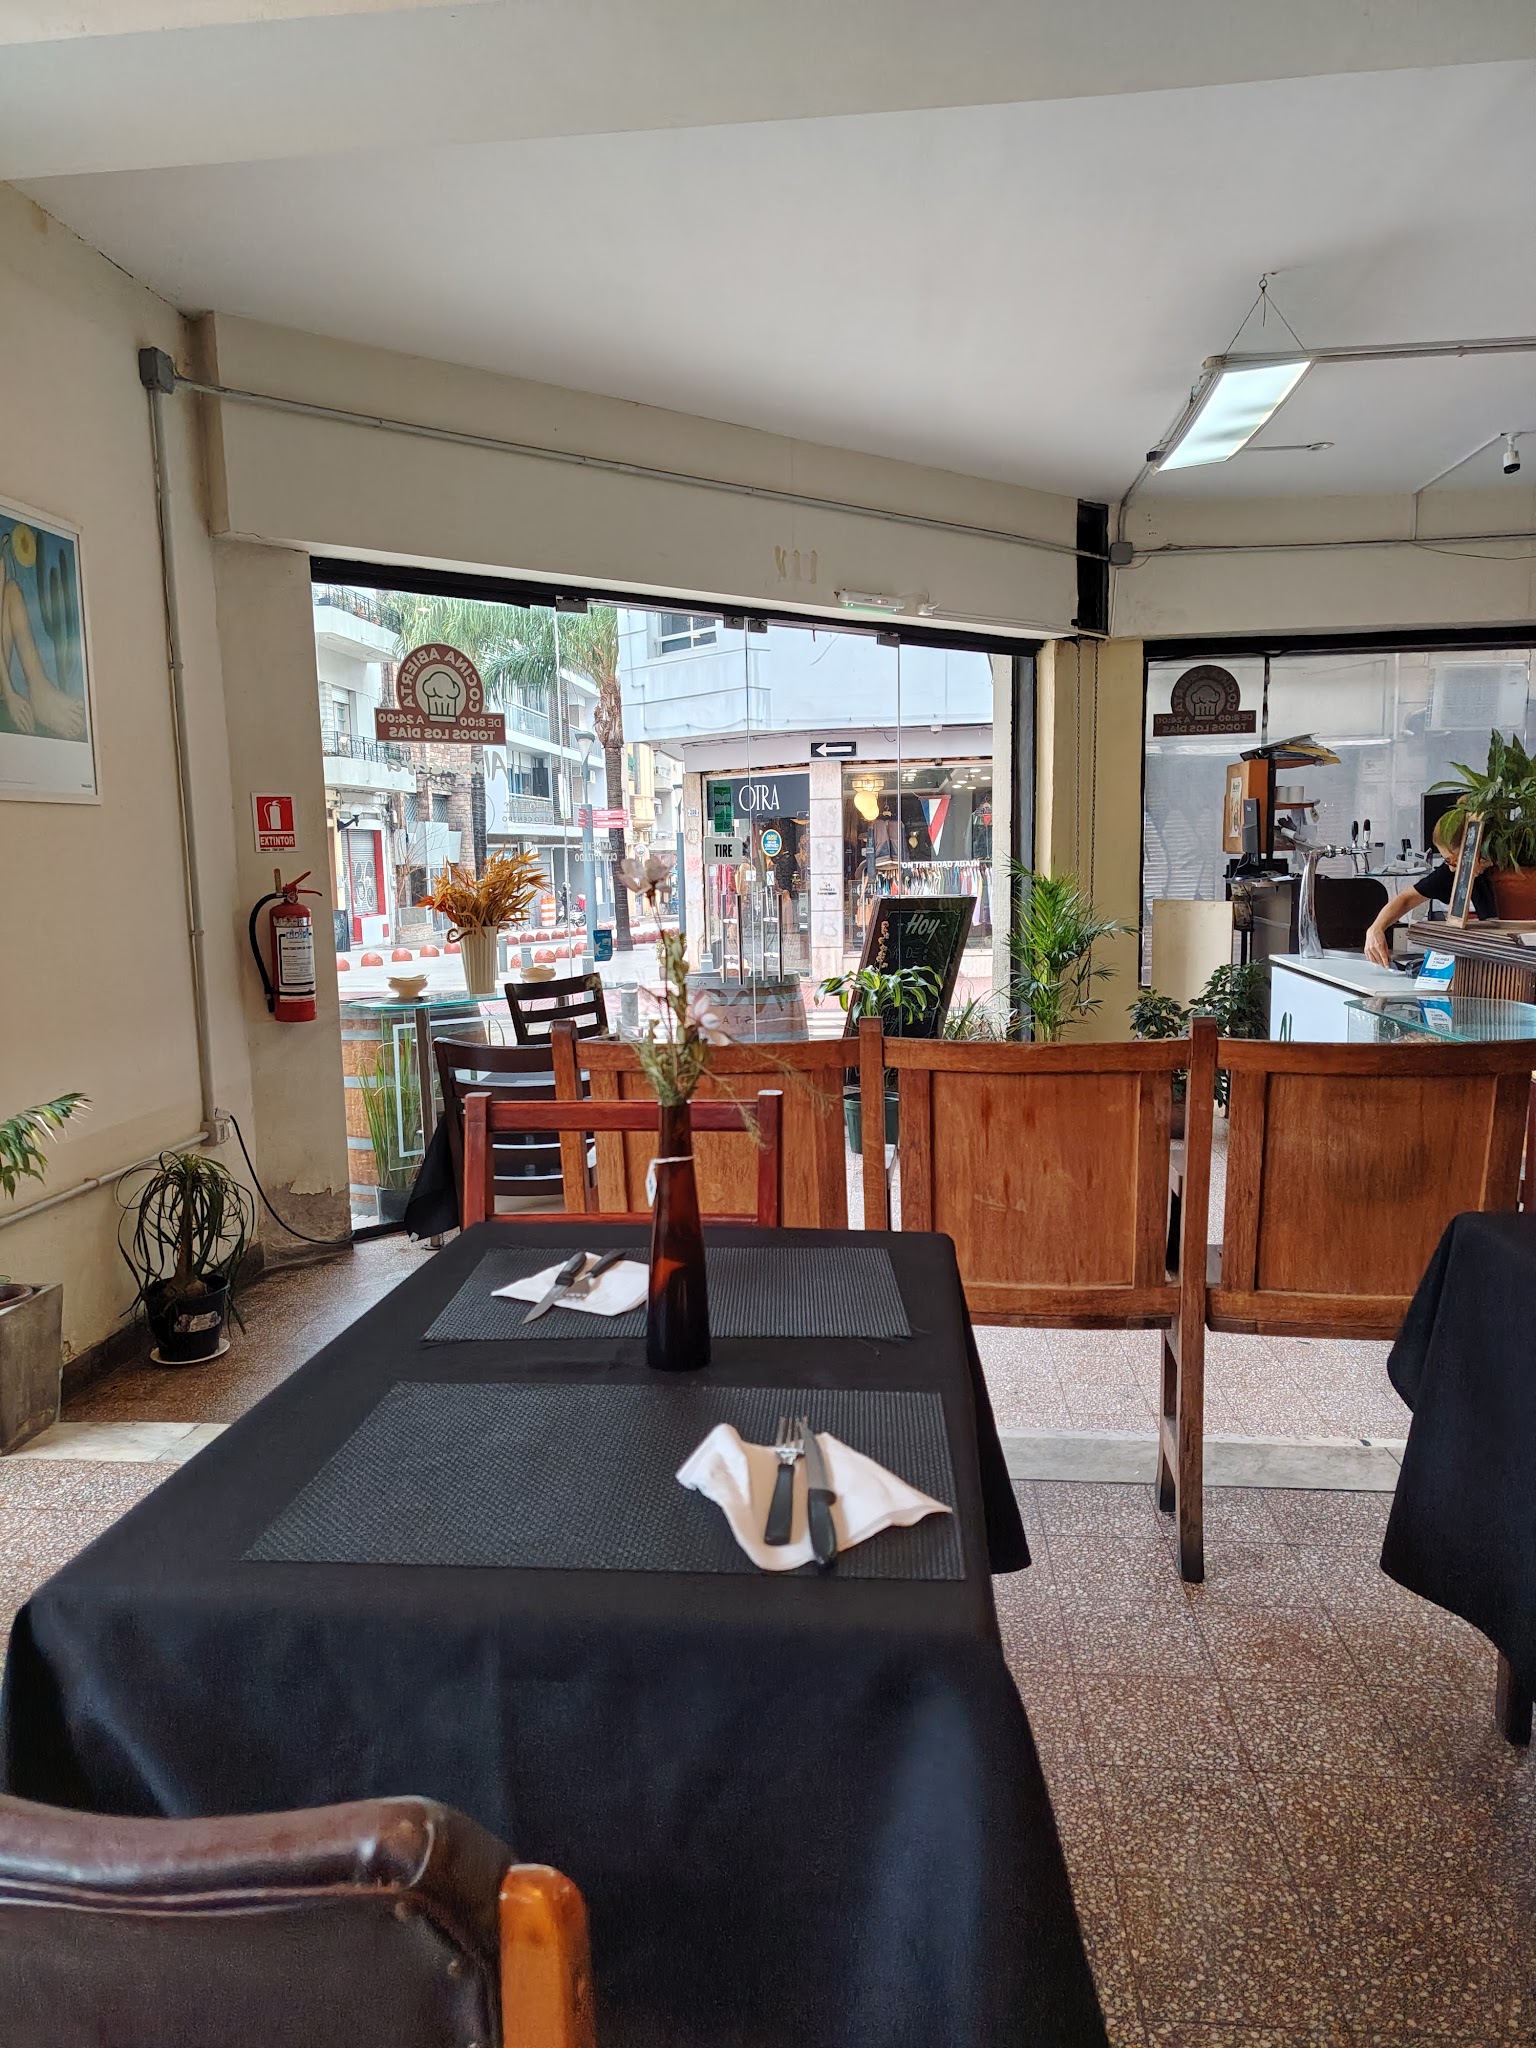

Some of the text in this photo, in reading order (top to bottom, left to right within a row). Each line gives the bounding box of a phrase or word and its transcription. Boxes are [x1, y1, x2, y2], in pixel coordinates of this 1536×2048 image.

[738, 783, 780, 812] OTRA
[260, 836, 295, 846] EXTINTOR
[714, 844, 733, 858] TIRE
[914, 860, 932, 869] THE
[931, 860, 954, 868] ROAD
[954, 859, 980, 868] AGAIN
[905, 914, 942, 945] Hoy
